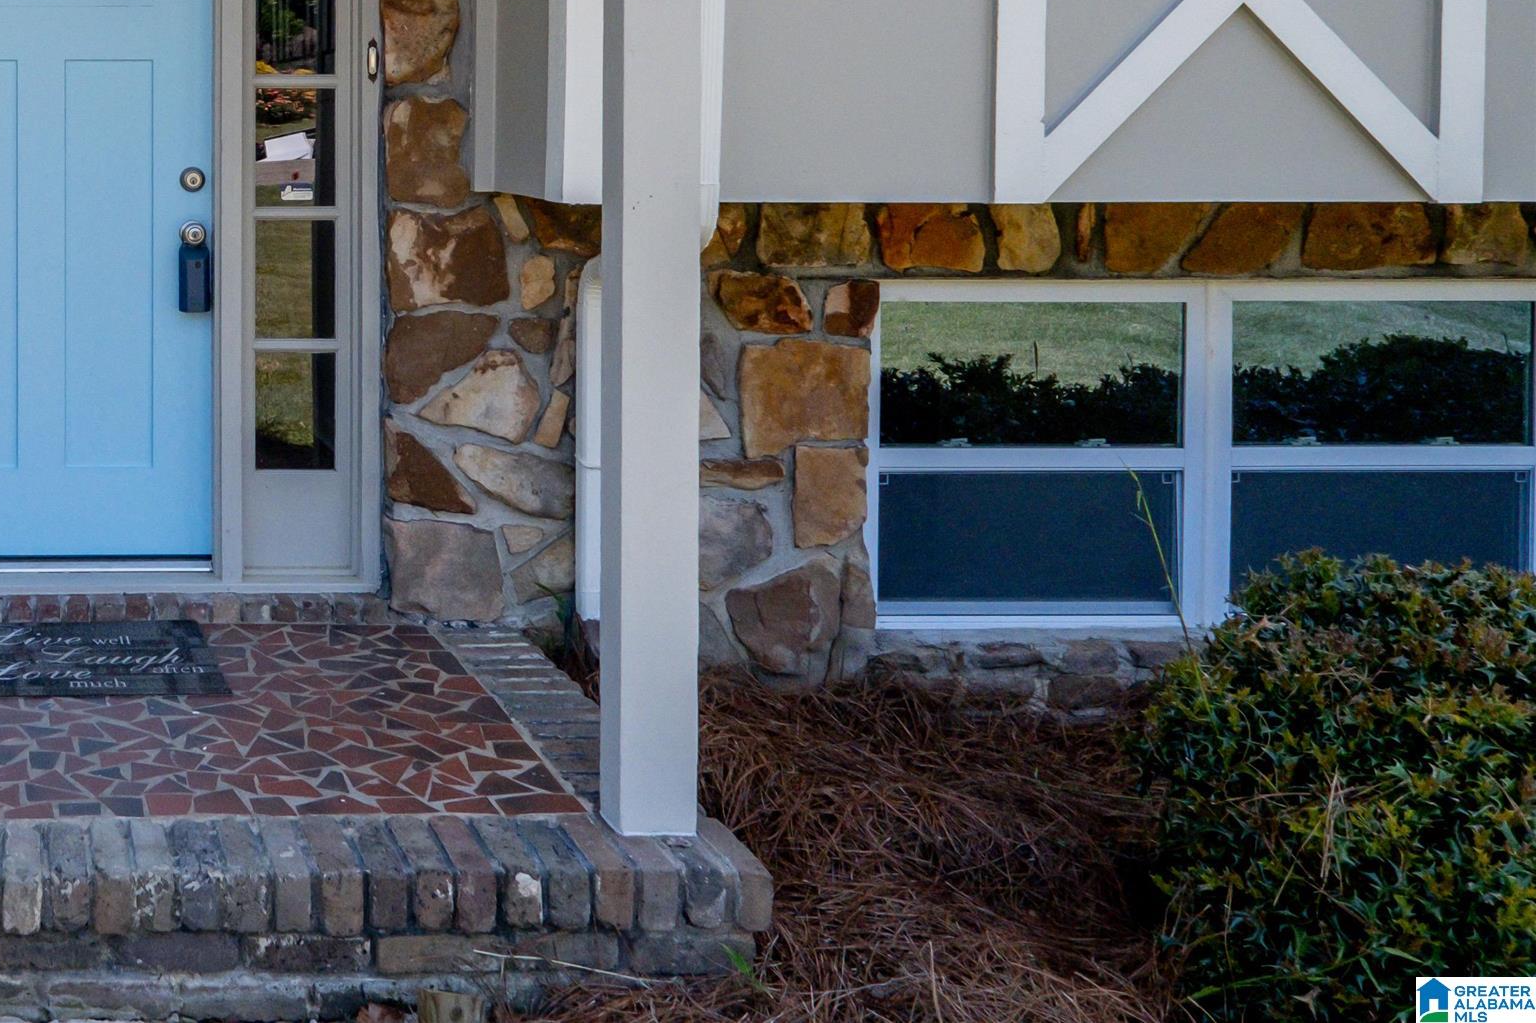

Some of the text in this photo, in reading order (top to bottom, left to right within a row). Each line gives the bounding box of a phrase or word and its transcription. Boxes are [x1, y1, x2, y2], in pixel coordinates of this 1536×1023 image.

[92, 635, 131, 646] well
[35, 646, 204, 674] Laugh often
[69, 678, 128, 689] much
